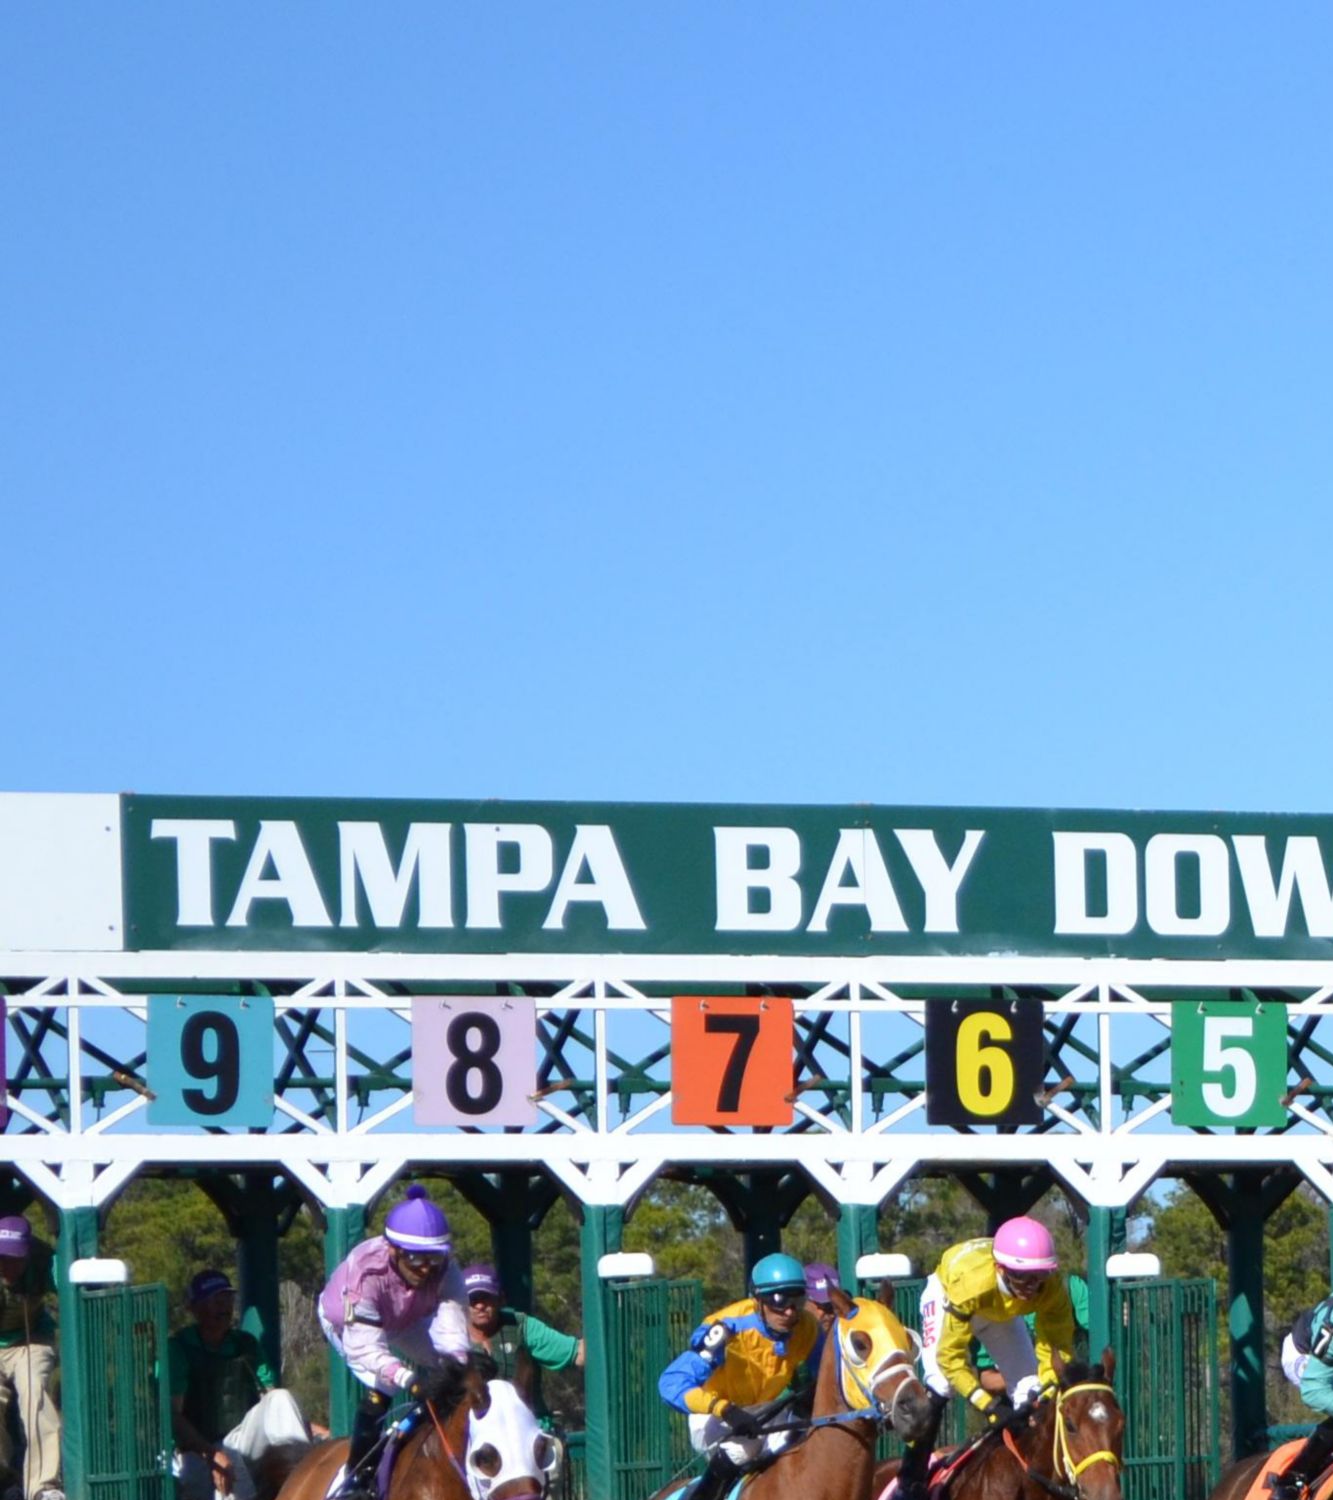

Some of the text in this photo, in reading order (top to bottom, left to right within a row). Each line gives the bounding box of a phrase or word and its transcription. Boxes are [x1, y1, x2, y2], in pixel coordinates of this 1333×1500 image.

[151, 819, 647, 930] TAMPA
[713, 826, 985, 933] BAY
[181, 1011, 240, 1115] 9
[446, 1013, 503, 1115] 8
[704, 1014, 760, 1113] 7
[954, 1012, 1014, 1116] 6
[1201, 1016, 1257, 1117] 5
[704, 1324, 723, 1347] 9
[1314, 1328, 1330, 1355] 7
